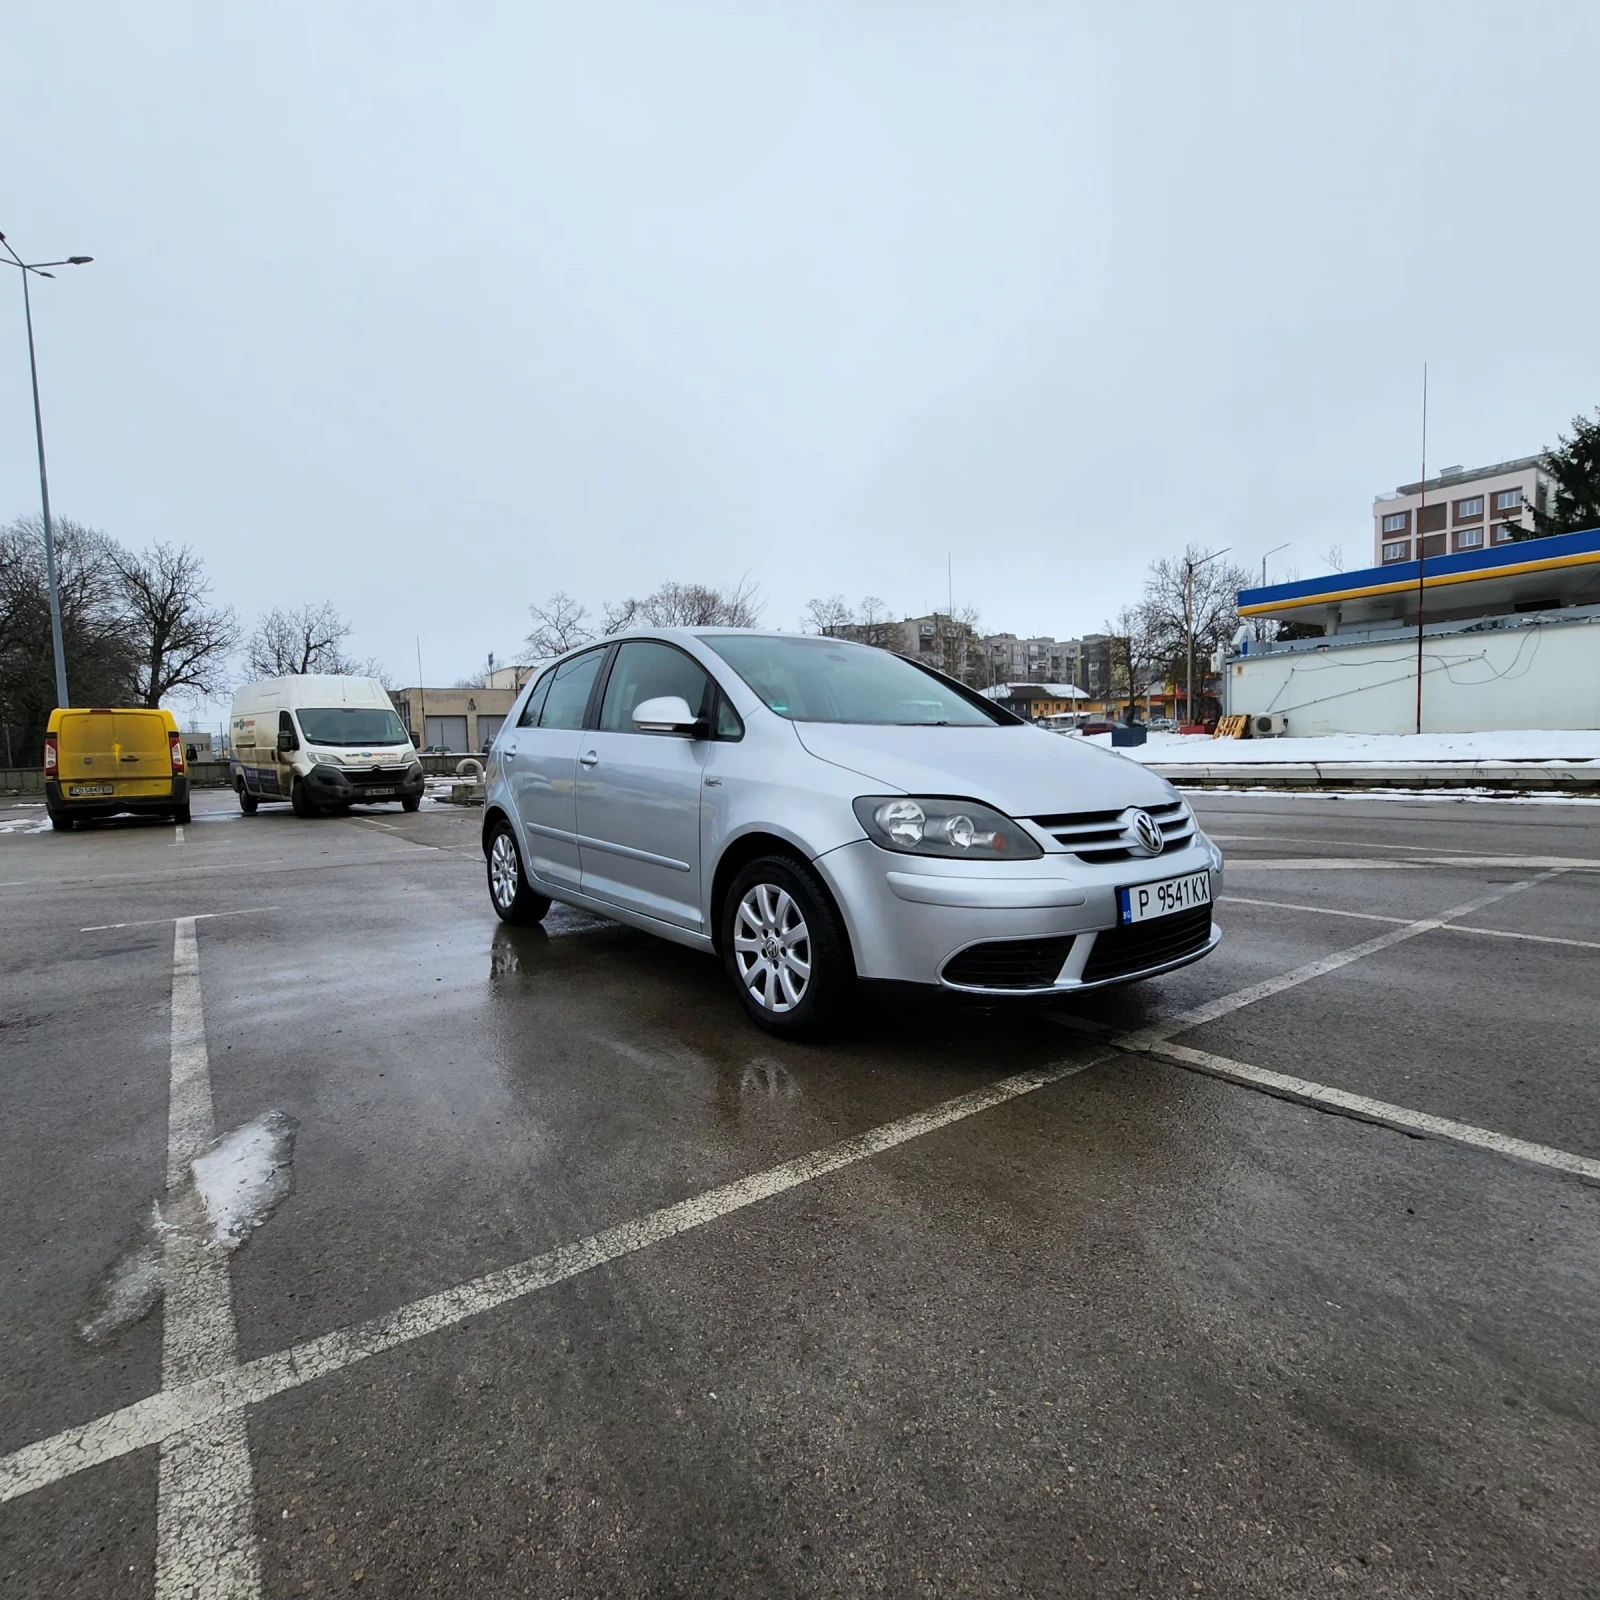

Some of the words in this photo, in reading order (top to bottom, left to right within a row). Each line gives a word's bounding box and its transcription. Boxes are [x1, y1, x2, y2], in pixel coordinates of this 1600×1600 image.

[1138, 889, 1150, 917] P
[1157, 880, 1190, 912] 9541
[1123, 911, 1131, 920] BG
